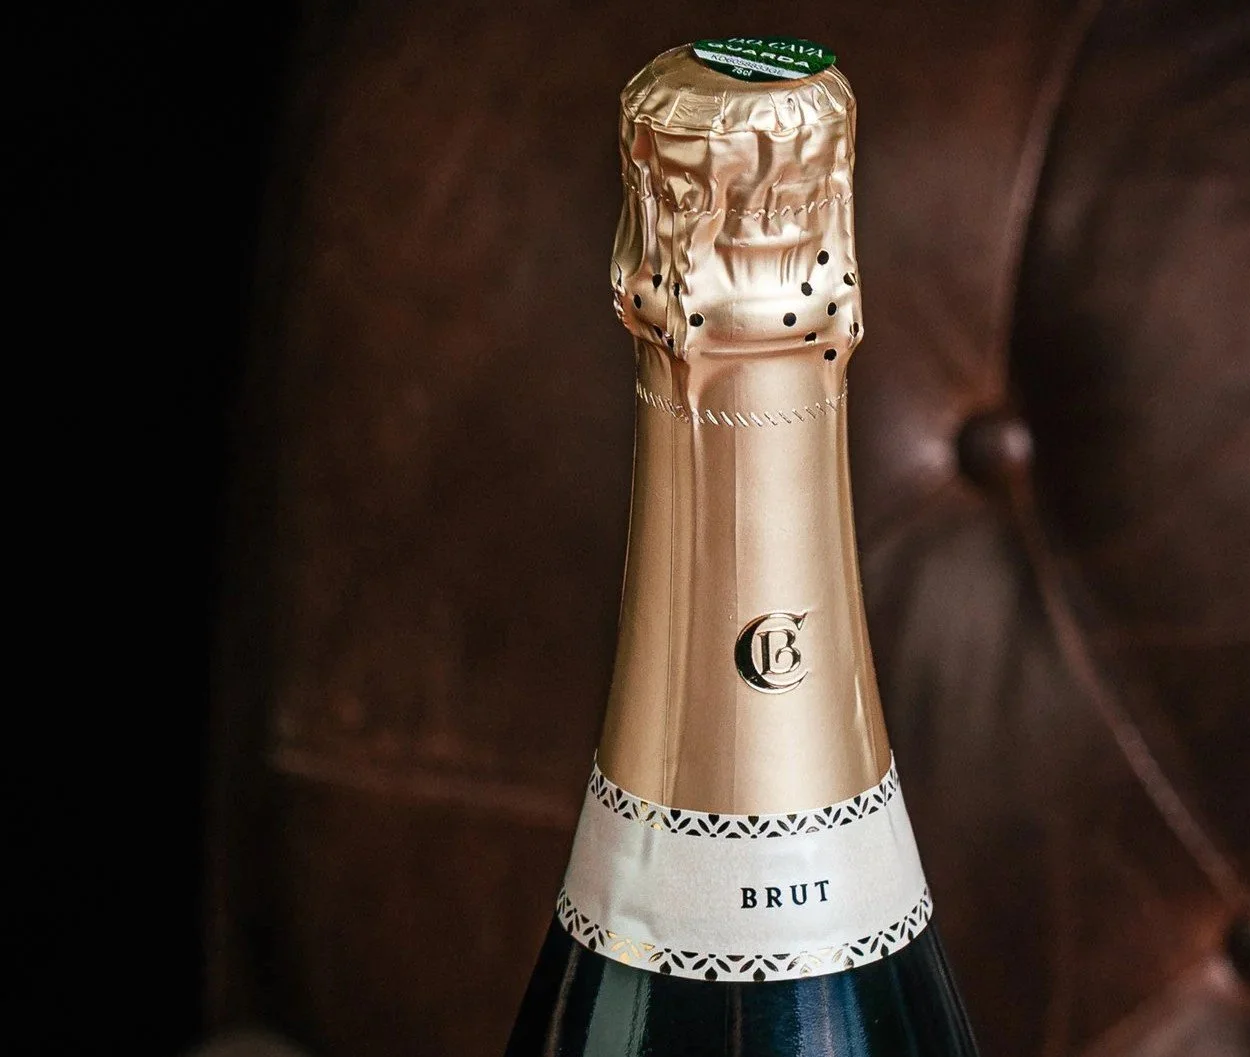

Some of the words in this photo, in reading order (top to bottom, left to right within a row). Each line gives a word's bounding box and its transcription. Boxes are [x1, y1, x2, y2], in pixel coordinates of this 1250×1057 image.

[708, 43, 810, 68] GUARDA
[768, 42, 823, 58] CAVA
[732, 66, 753, 77] 75cl
[740, 879, 830, 909] BRUT
